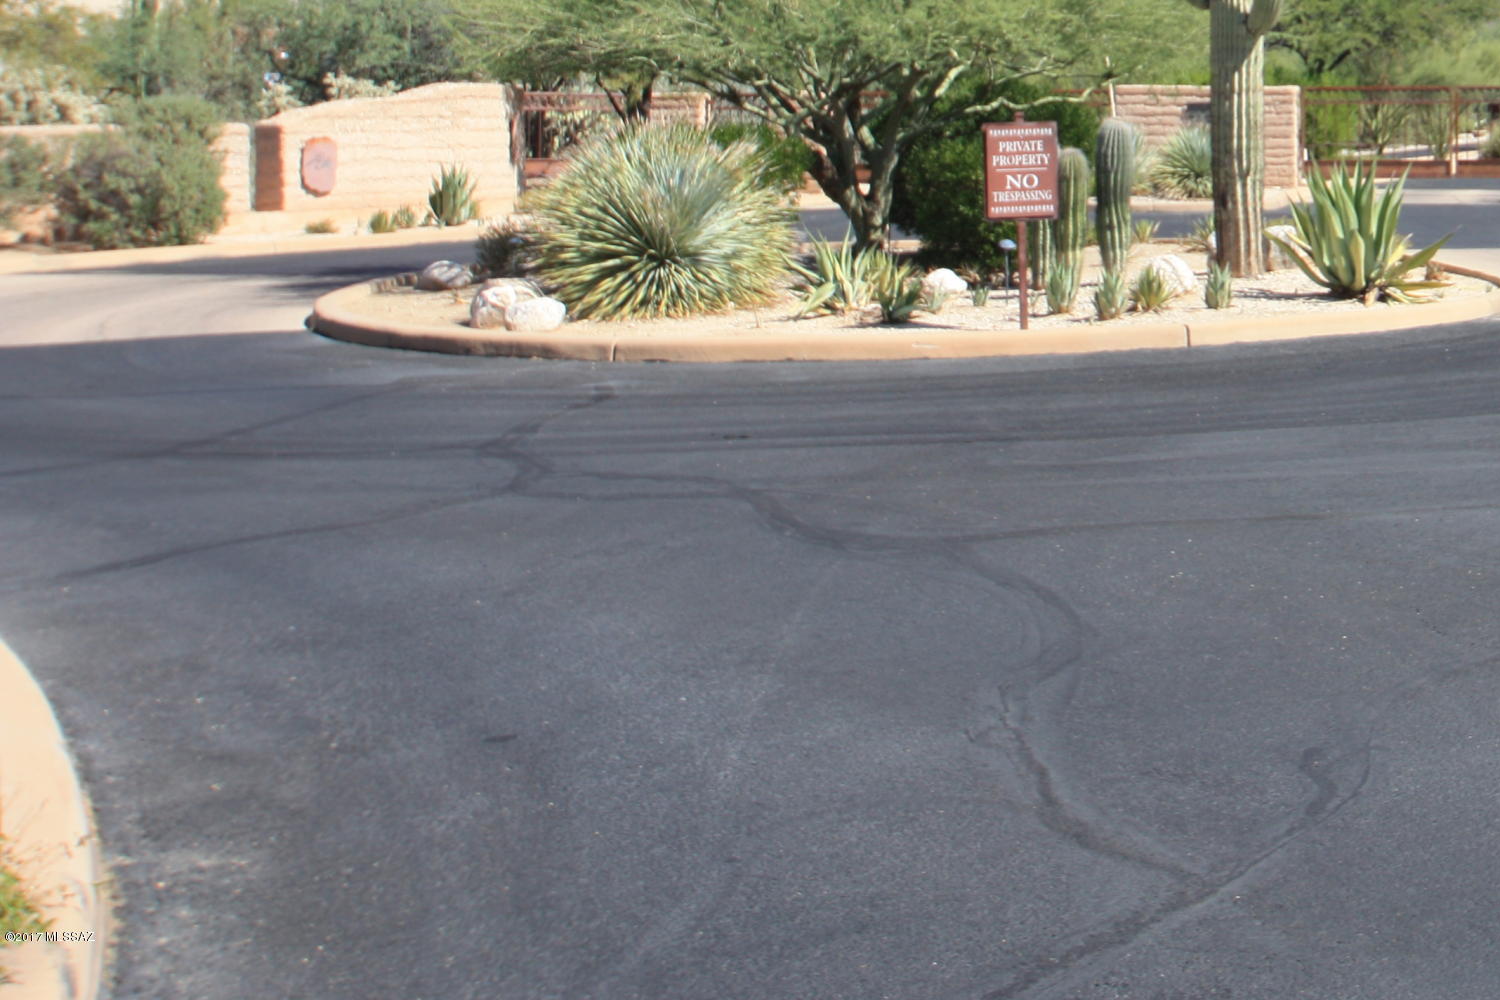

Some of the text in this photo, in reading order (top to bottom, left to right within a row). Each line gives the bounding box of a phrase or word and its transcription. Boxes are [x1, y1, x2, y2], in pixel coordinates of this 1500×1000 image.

[999, 140, 1043, 152] PRIVATE
[992, 153, 1050, 166] PROPERTY
[1006, 173, 1038, 189] NO
[992, 189, 1052, 202] TRESPASSING
